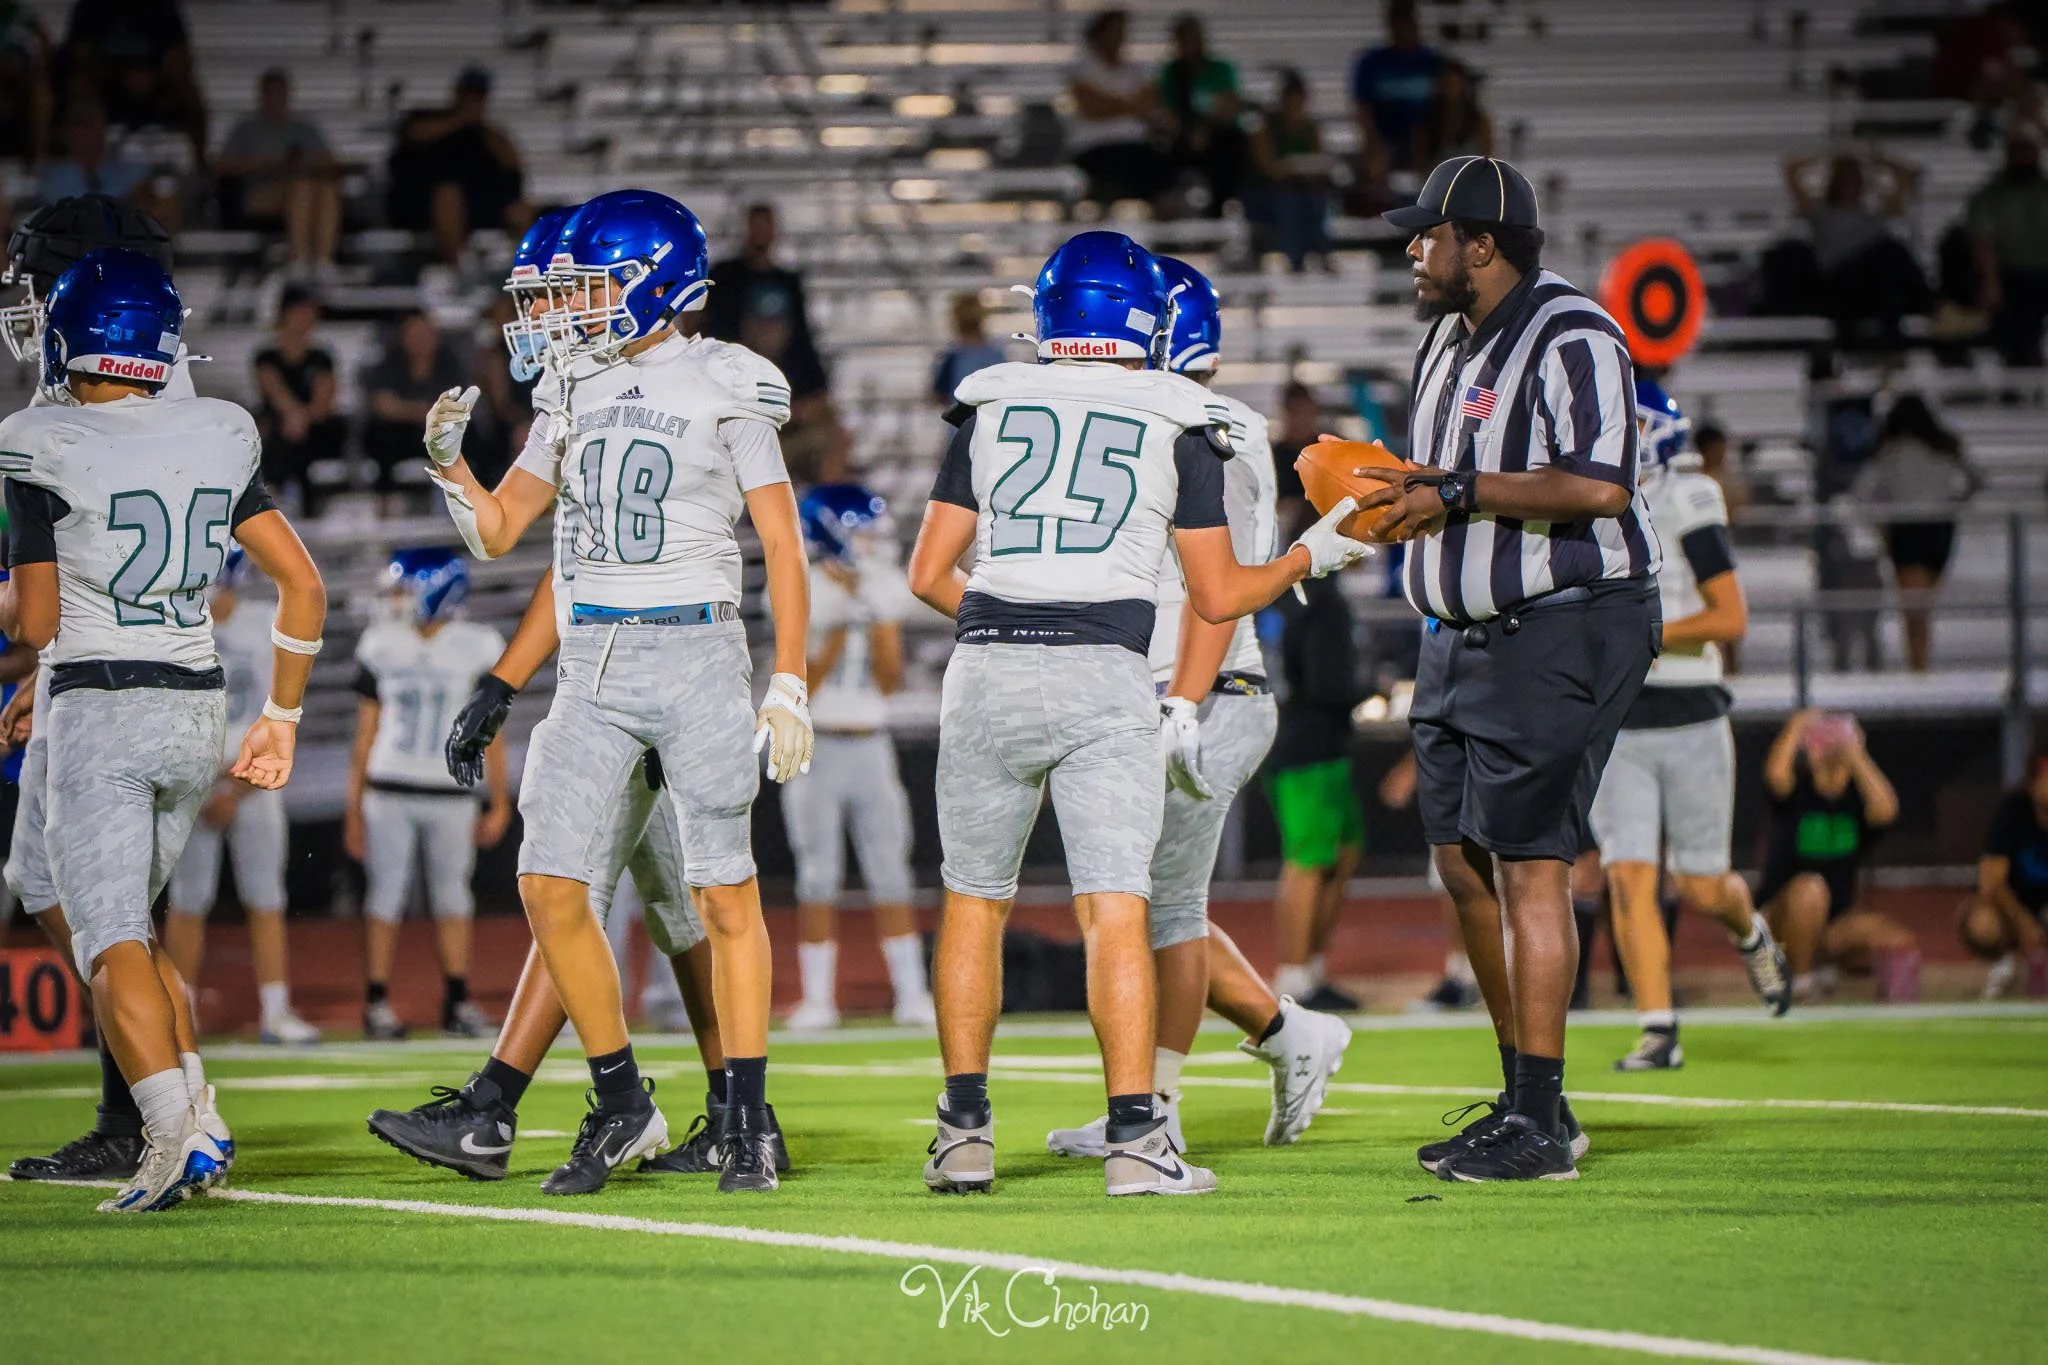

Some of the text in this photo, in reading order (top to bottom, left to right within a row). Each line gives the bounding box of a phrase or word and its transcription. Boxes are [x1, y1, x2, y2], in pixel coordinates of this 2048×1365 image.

[98, 357, 165, 380] Riddell
[1051, 342, 1117, 356] Riddell
[623, 406, 691, 438] VALLEY
[580, 439, 673, 564] 18
[990, 405, 1147, 557] 25
[107, 488, 232, 628] 26
